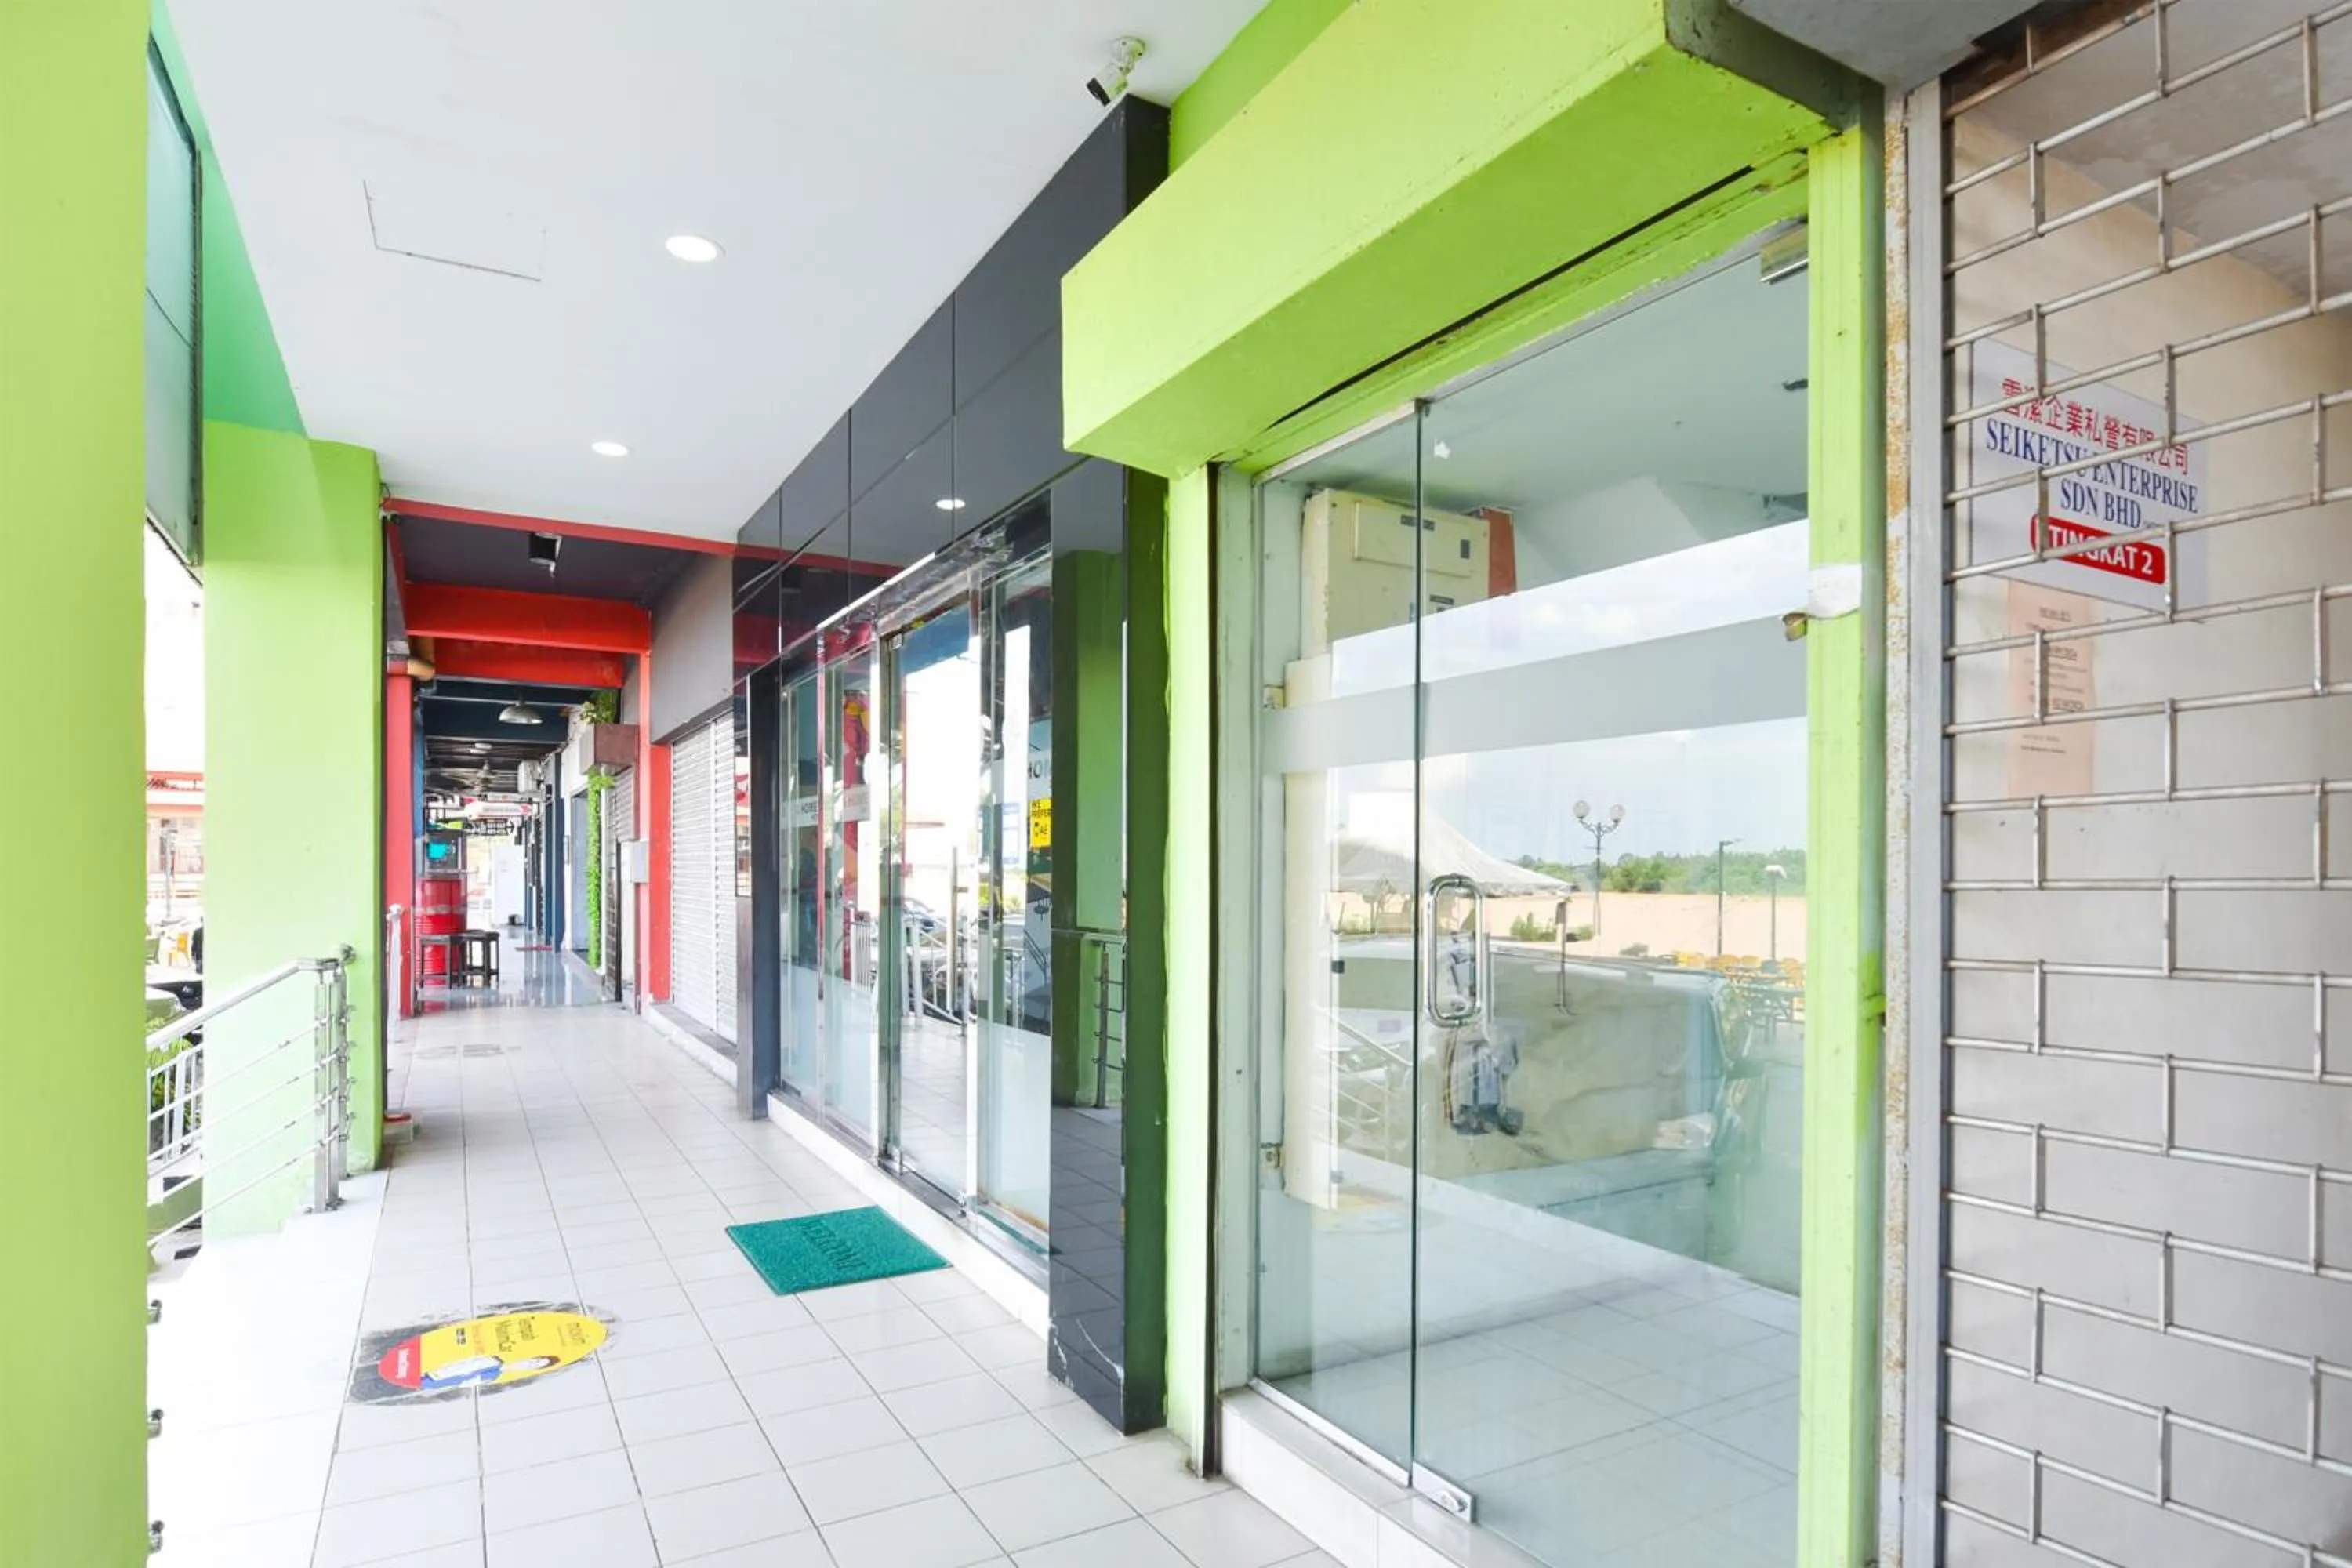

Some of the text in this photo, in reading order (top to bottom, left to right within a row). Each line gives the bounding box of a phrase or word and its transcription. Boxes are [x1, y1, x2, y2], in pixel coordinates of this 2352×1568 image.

[1986, 417, 2198, 514] SEIKETSU ENTERPRISE
[2060, 477, 2142, 529] SDN BHD
[2141, 551, 2154, 574] 2
